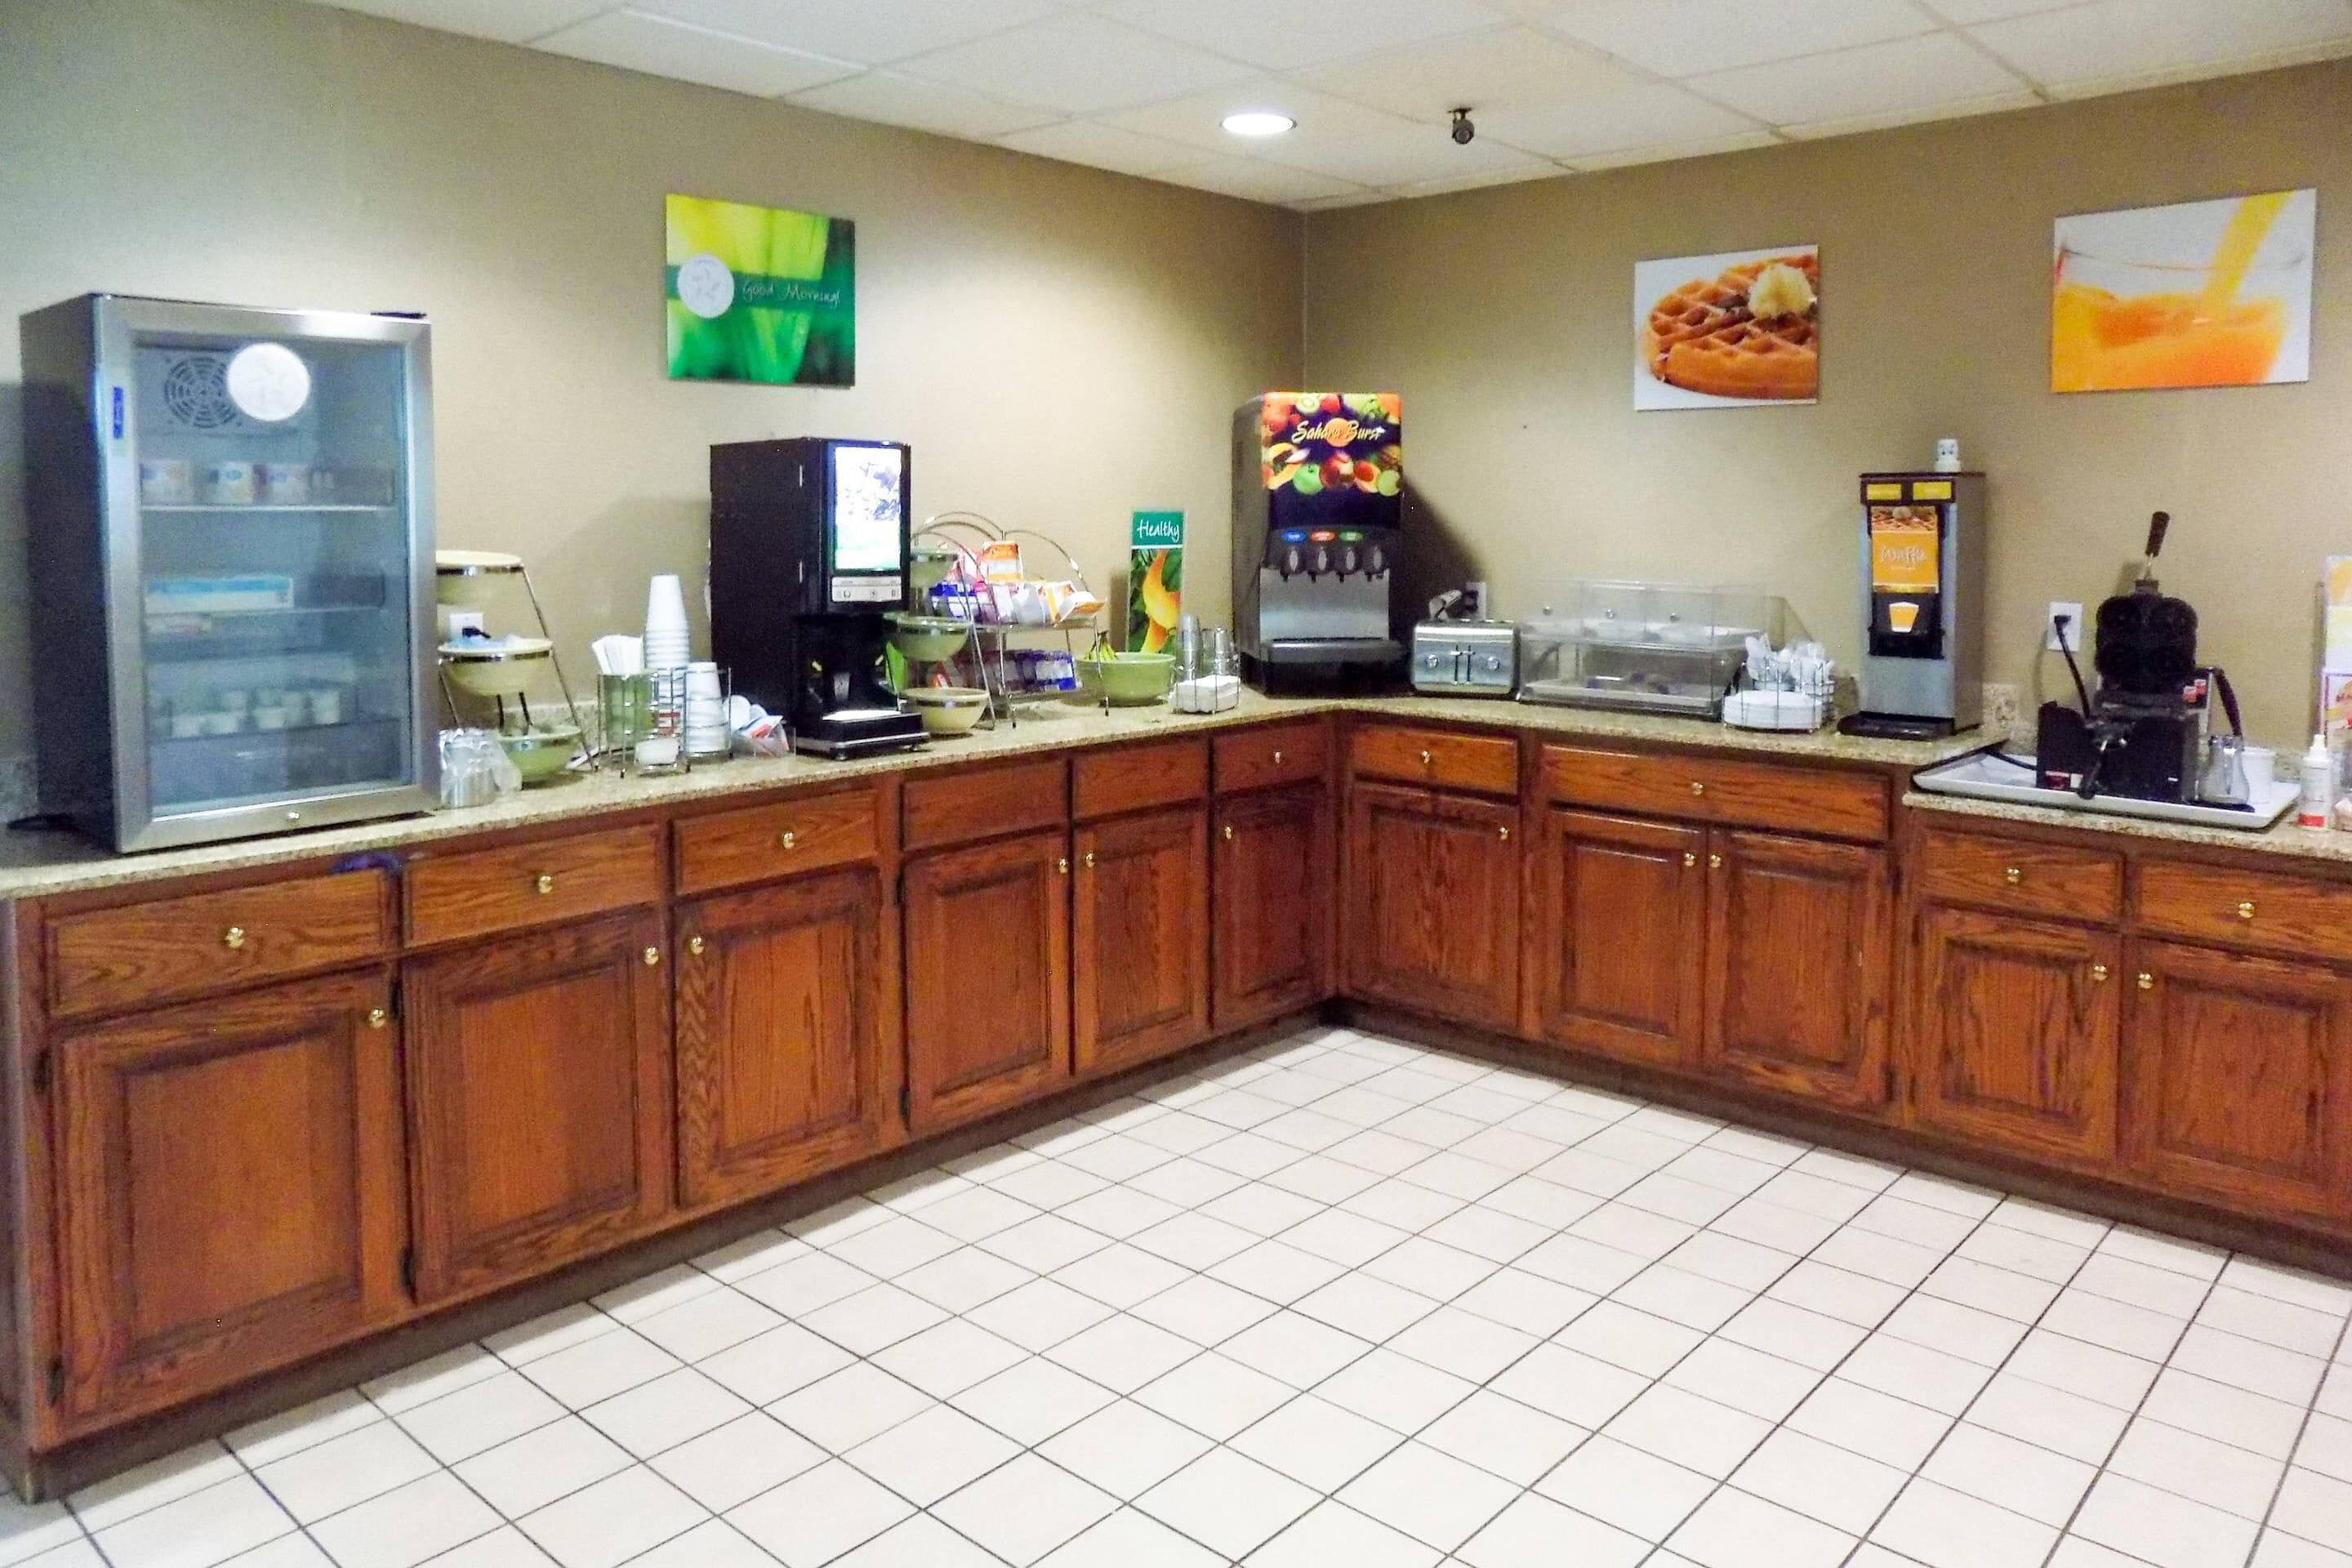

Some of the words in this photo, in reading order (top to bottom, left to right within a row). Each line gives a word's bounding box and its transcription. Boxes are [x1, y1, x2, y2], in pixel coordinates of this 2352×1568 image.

[742, 281, 774, 302] Good
[1291, 421, 1342, 443] Sahara
[1344, 420, 1383, 441] Burst
[1136, 519, 1180, 543] Healthy
